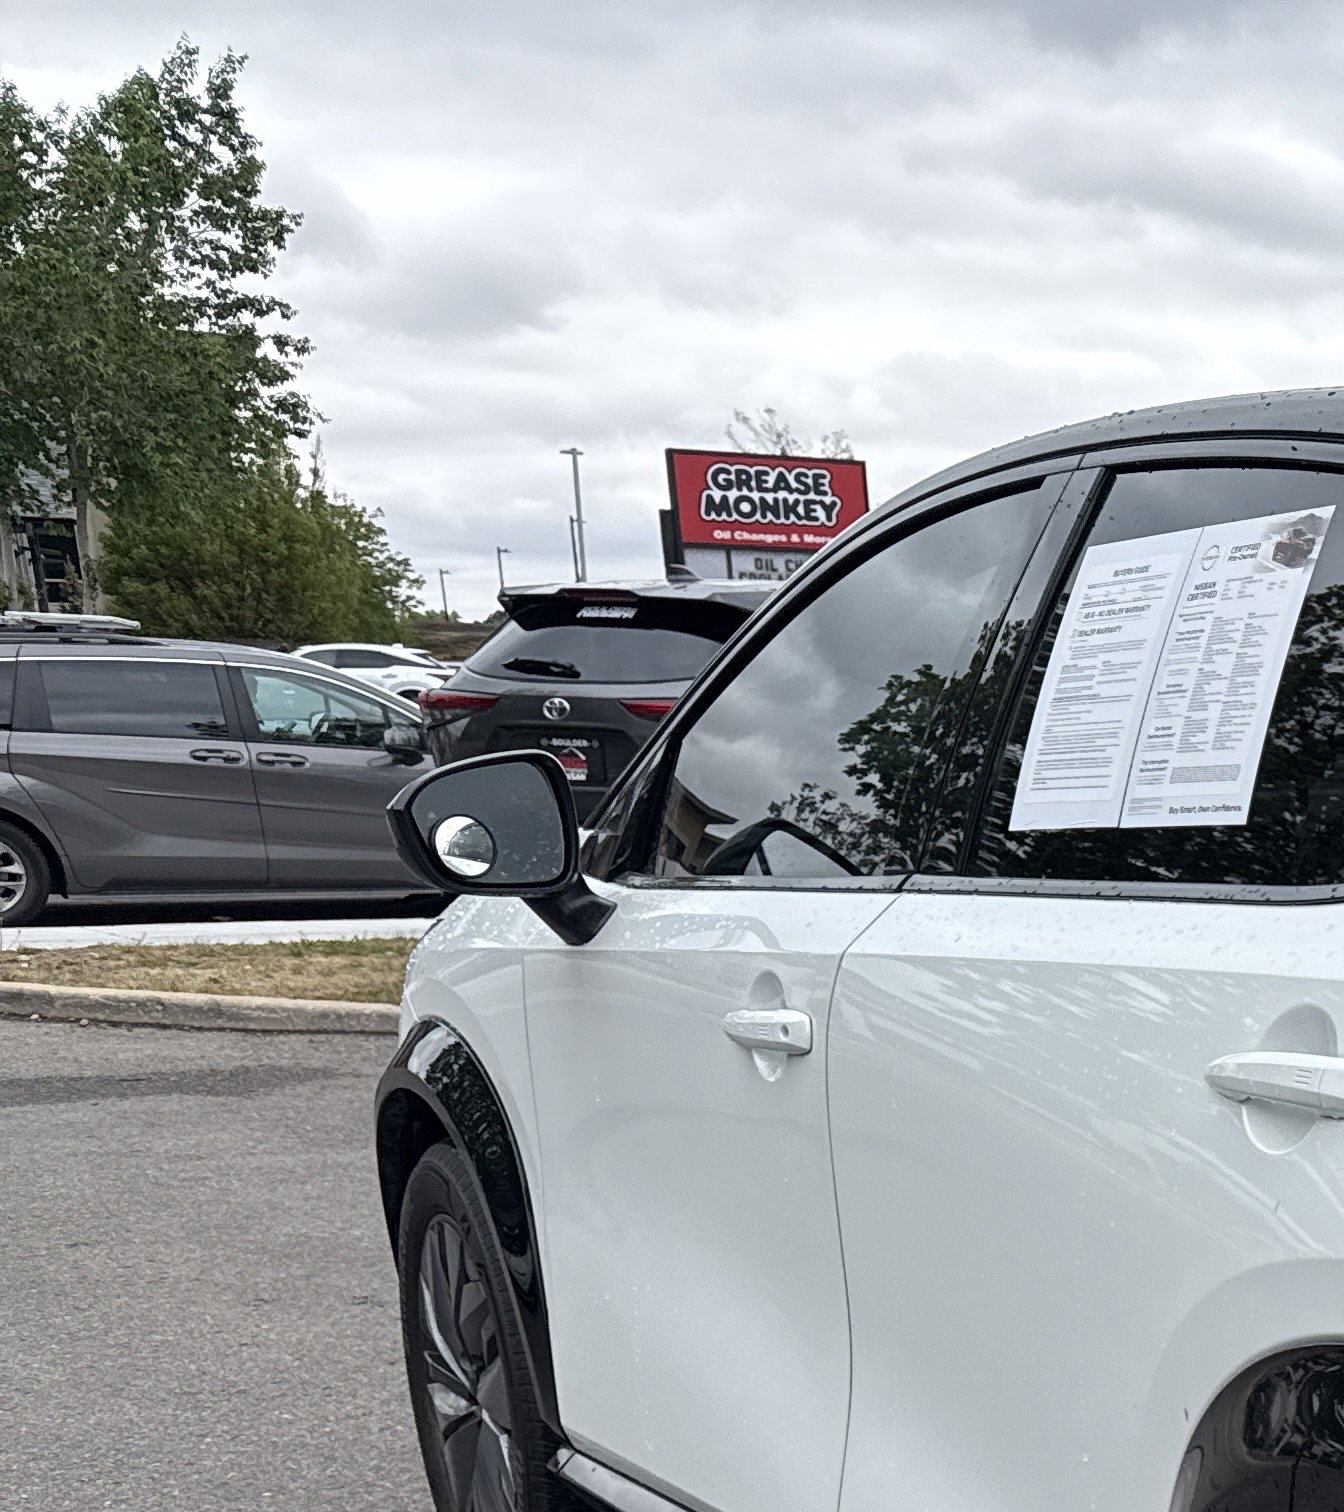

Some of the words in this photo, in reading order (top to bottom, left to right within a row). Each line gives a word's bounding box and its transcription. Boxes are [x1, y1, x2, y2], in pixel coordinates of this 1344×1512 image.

[708, 465, 831, 497] GREASE
[702, 493, 839, 524] MONKEY
[713, 529, 731, 540] Oil
[734, 530, 787, 543] Changes
[790, 533, 800, 543] &
[754, 557, 779, 572] OIL
